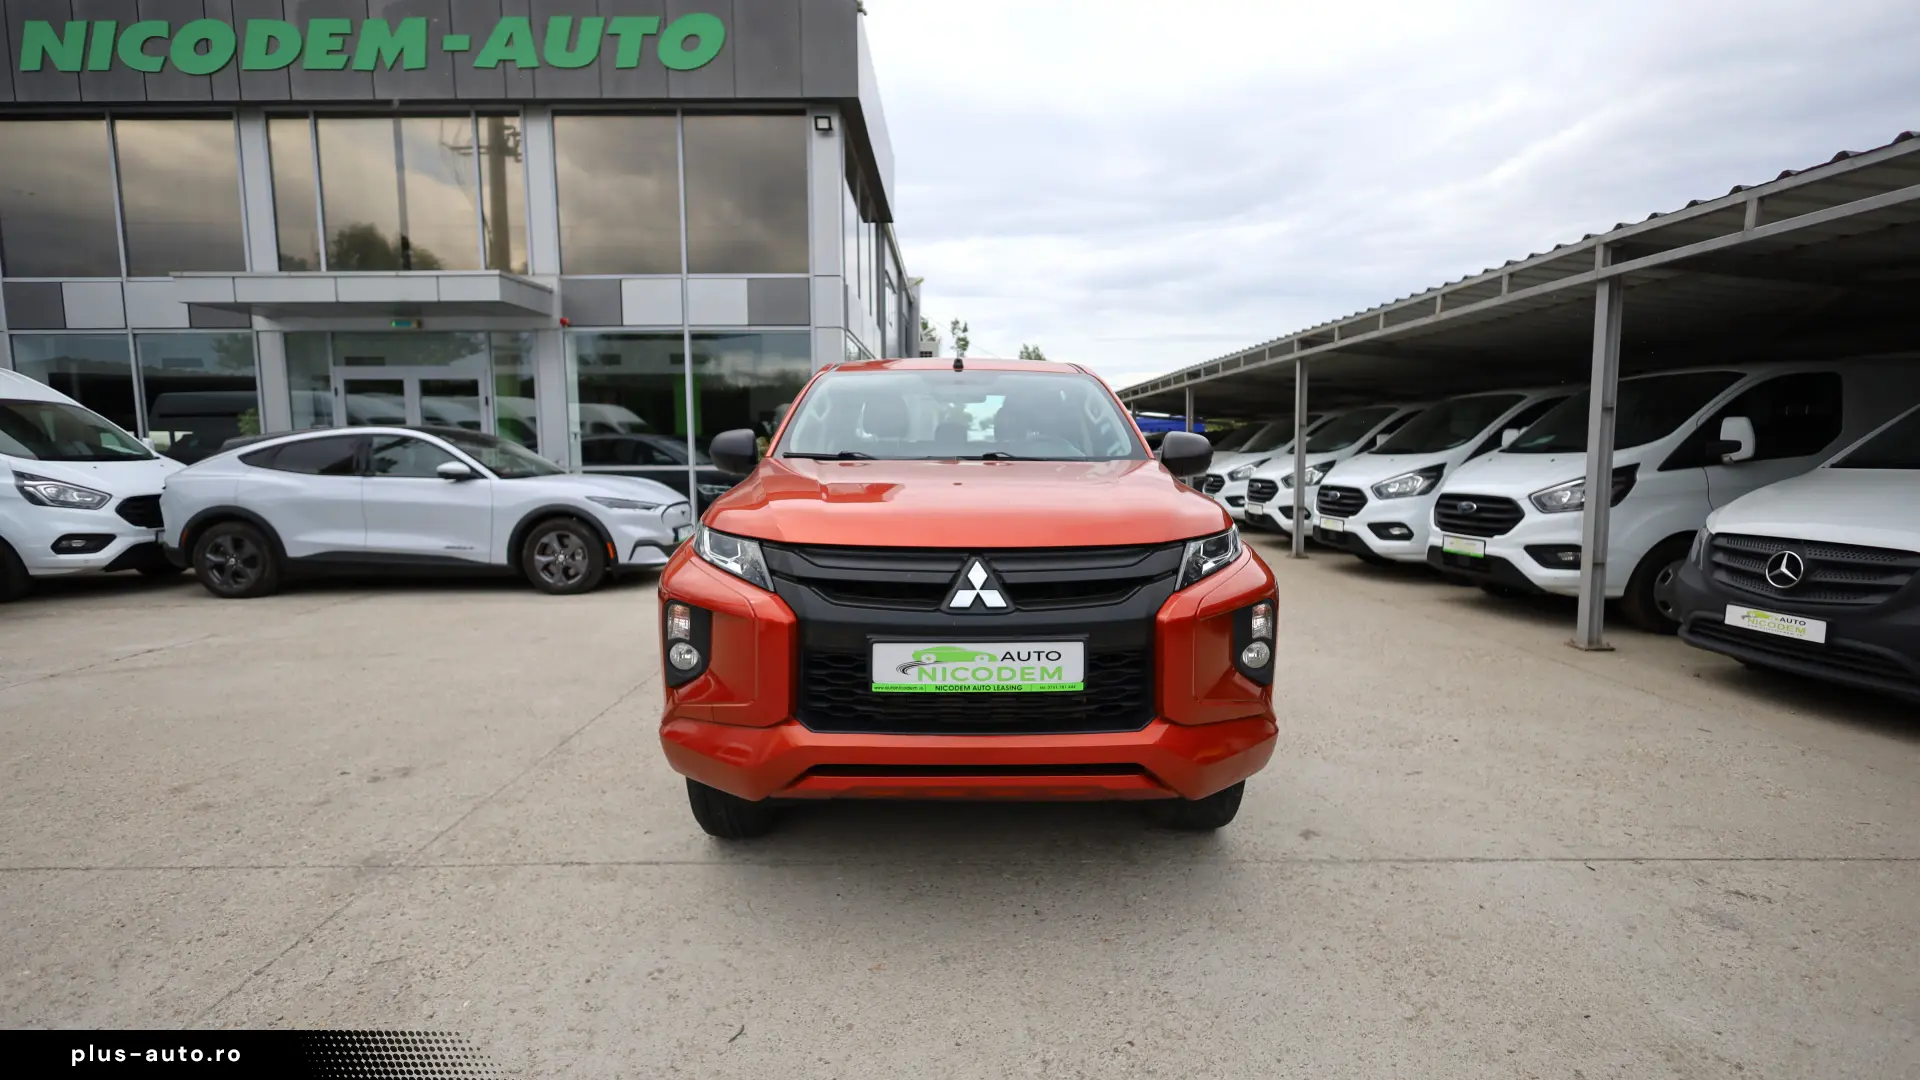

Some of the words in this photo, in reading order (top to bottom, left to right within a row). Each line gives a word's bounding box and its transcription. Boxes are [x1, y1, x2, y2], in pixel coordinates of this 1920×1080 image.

[19, 17, 428, 75] NICODEM
[473, 12, 726, 71] AUTO
[1747, 618, 1807, 635] NICODEM
[1779, 617, 1807, 626] AUTO
[1000, 650, 1062, 662] AUTO
[917, 665, 1063, 682] NICODEM
